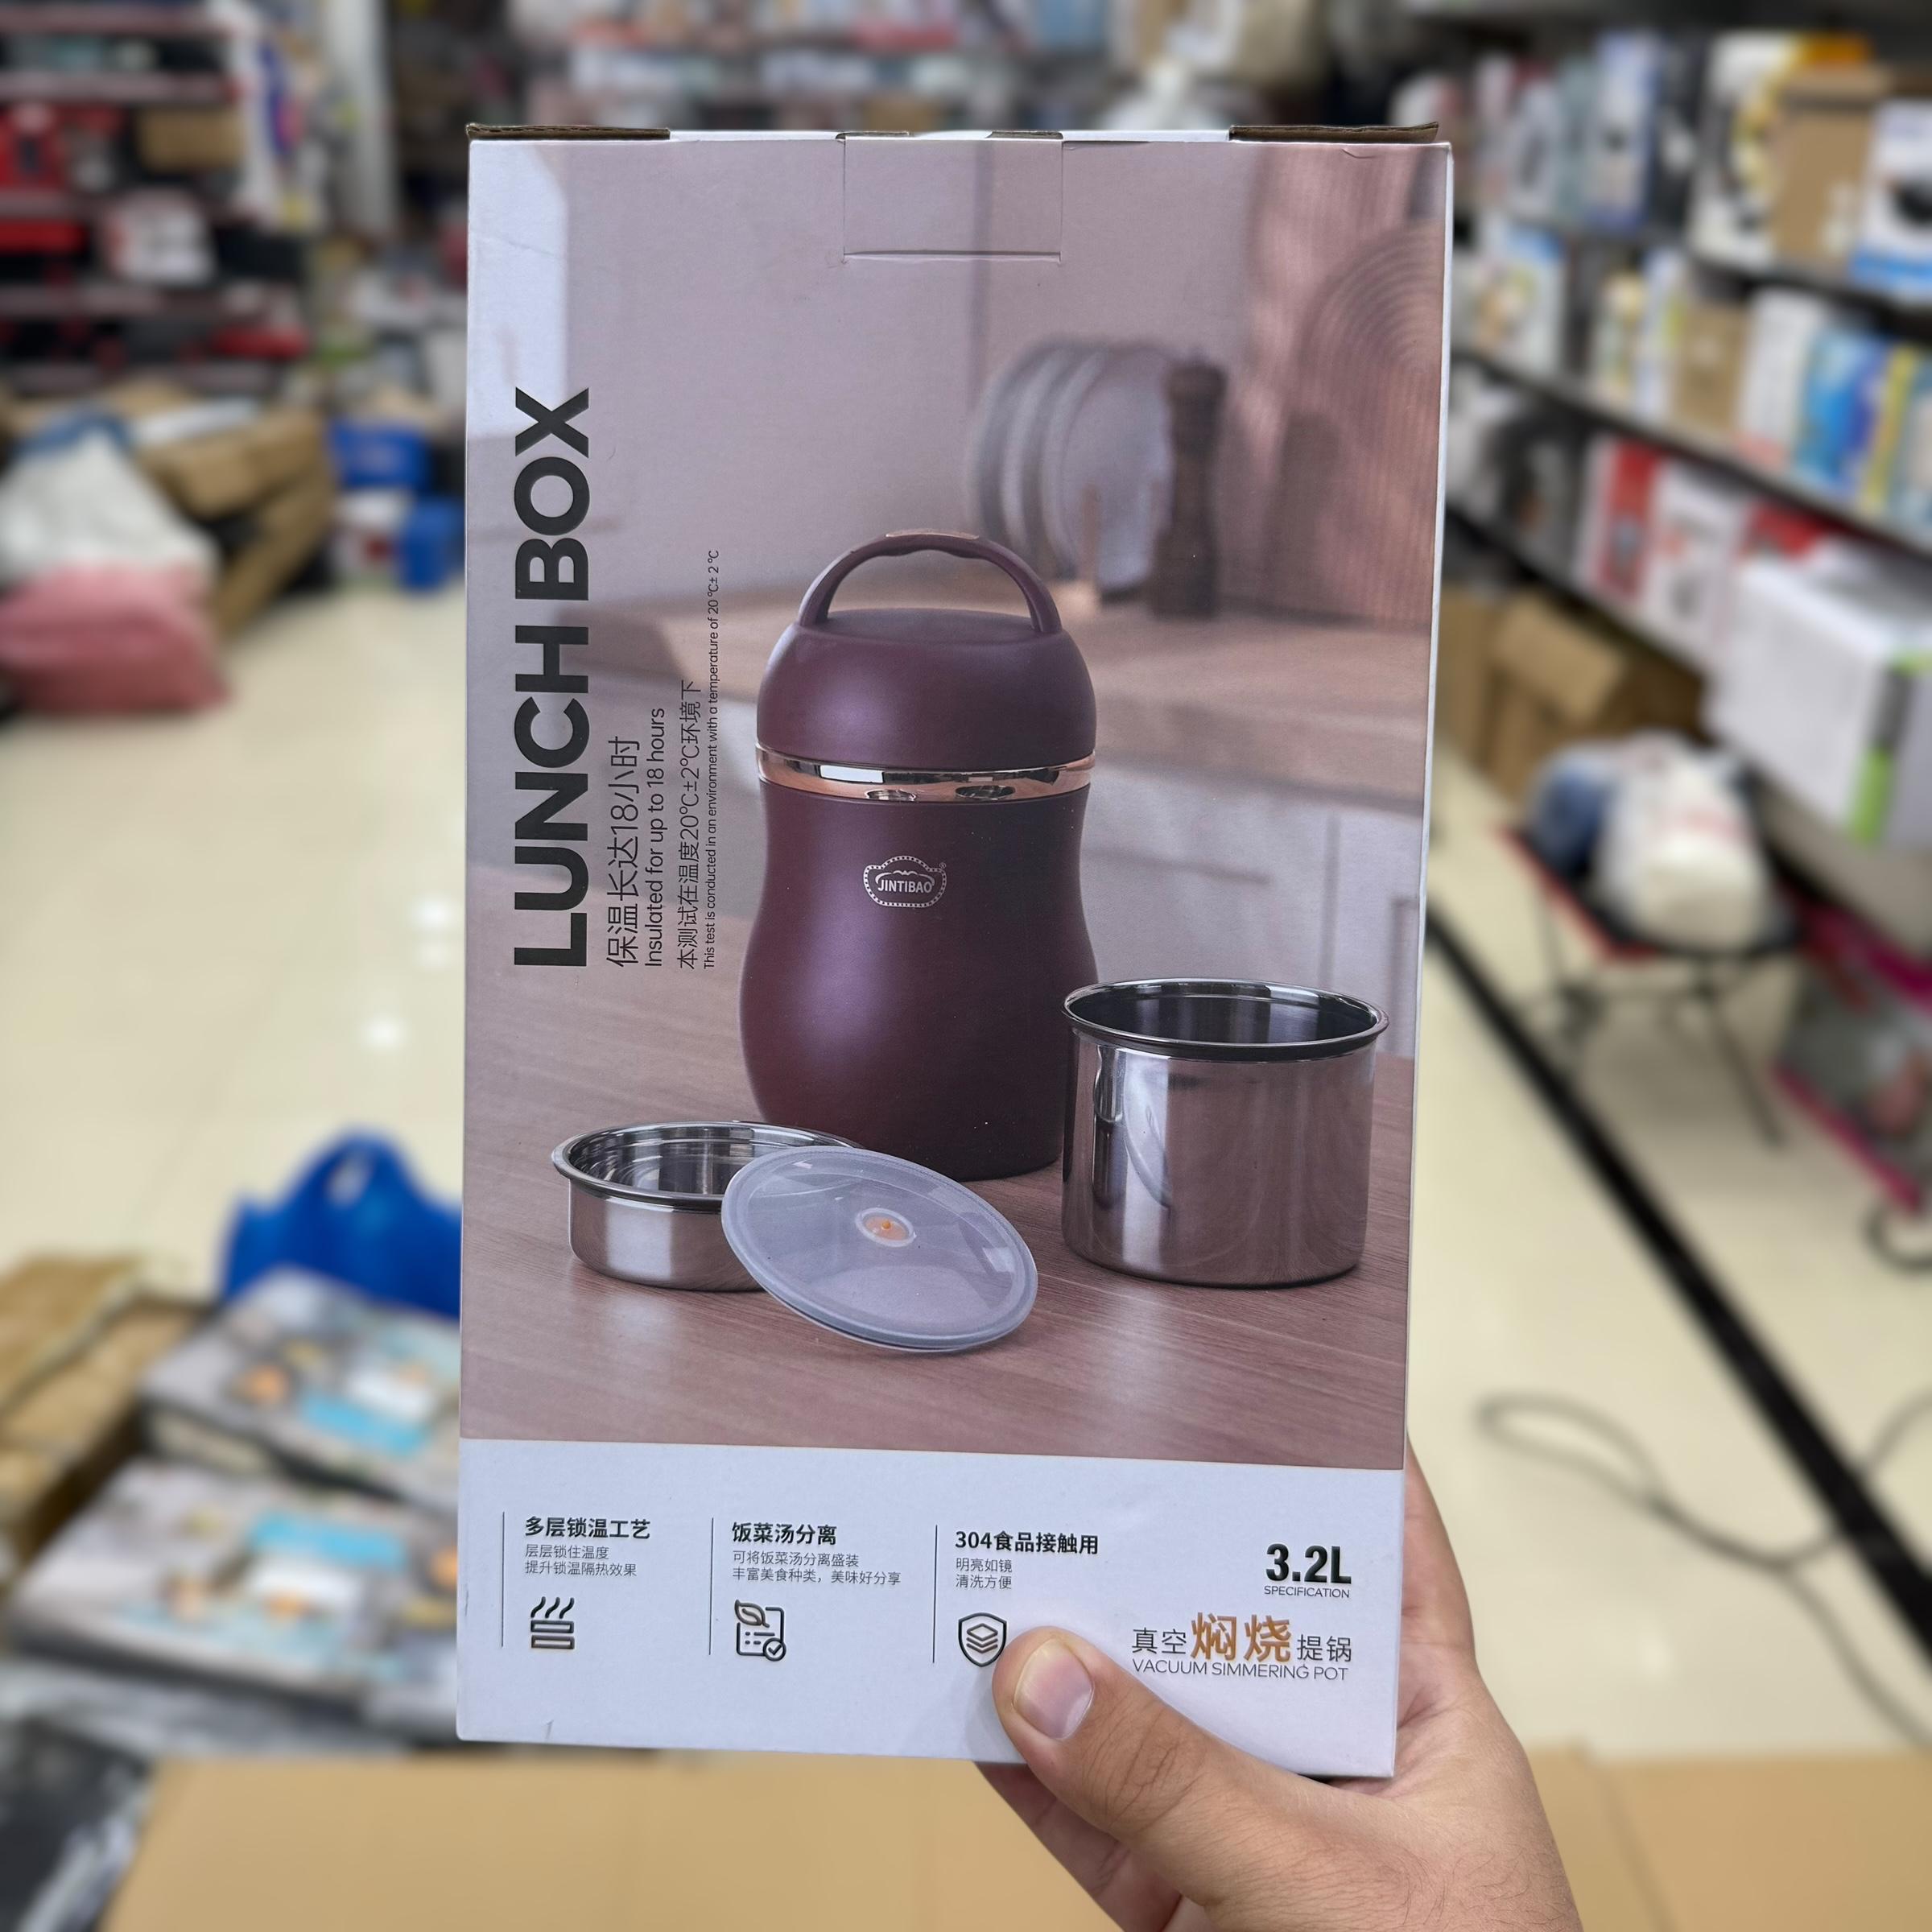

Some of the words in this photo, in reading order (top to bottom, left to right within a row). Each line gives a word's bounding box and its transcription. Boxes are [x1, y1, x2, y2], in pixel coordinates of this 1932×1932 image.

[514, 387, 590, 601] BOX
[708, 599, 718, 615] 20
[707, 617, 718, 630] of
[708, 632, 720, 704] temperature
[709, 707, 718, 715] a
[646, 708, 665, 762] hours
[707, 717, 718, 742] with
[646, 768, 663, 789] 18
[706, 745, 717, 816] environment
[514, 625, 588, 968] LUNCH
[647, 794, 663, 813] to
[650, 818, 668, 842] up
[708, 819, 716, 834] an
[605, 736, 640, 968] 保温长达18小时
[705, 837, 716, 847] in
[645, 848, 663, 875] for
[705, 849, 716, 909] conducted
[877, 879, 933, 894] JINTIBAO
[644, 881, 663, 966] Insulated
[705, 911, 715, 920] is
[704, 923, 715, 945] test
[704, 947, 715, 969] This
[525, 1516, 650, 1539] 多层锁温工艺
[732, 1521, 837, 1545] 饭菜汤分离
[525, 1543, 609, 1559] 层层锁住温度
[955, 1530, 1099, 1554] 304食品接触用
[524, 1561, 638, 1577] 提升锁温隔热效果
[733, 1550, 859, 1567] 可将饭菜汤分离盛装
[956, 1558, 1013, 1573] 明亮如镜
[1265, 1543, 1352, 1584] 3.2L
[956, 1574, 1012, 1589] 清洗方便
[1264, 1585, 1350, 1598] SPECIFICATION
[1132, 1658, 1208, 1675] VACUUM
[1211, 1662, 1309, 1679] SIMMERING
[1314, 1666, 1348, 1680] POT
